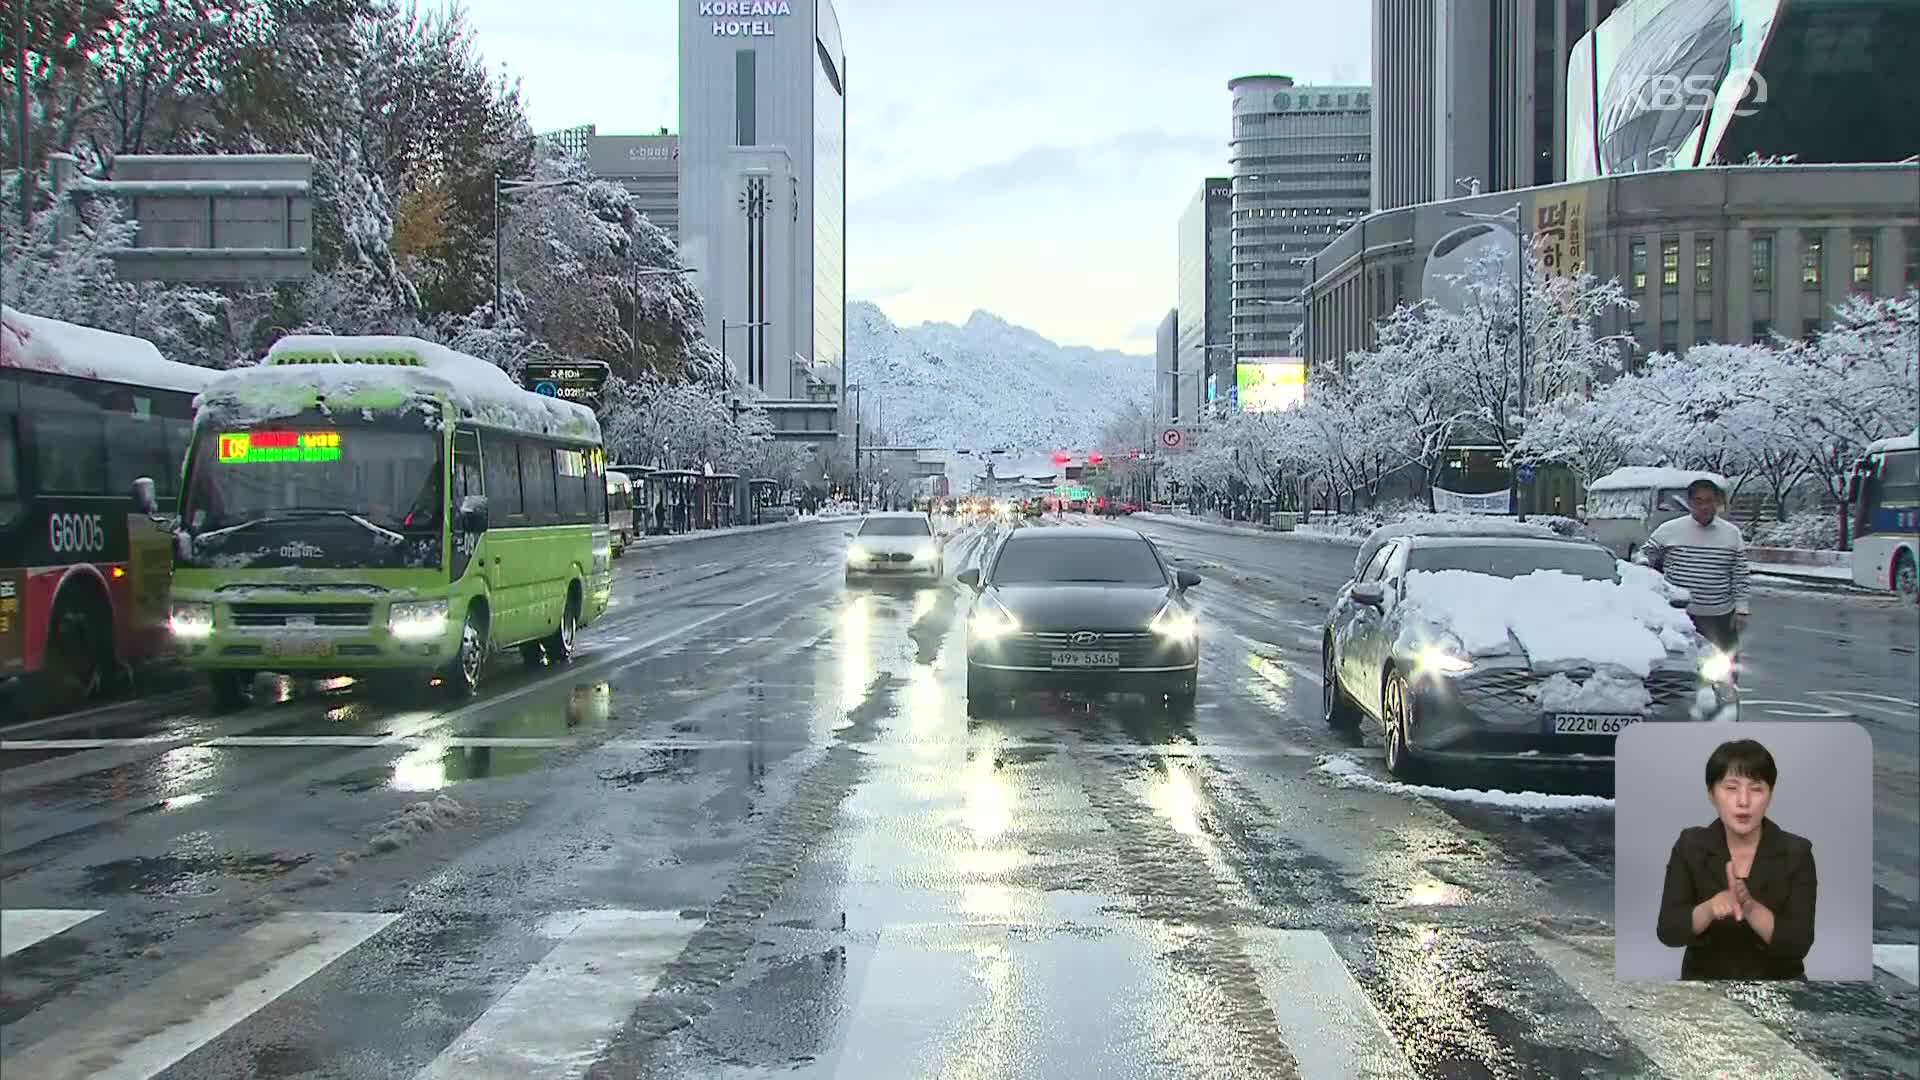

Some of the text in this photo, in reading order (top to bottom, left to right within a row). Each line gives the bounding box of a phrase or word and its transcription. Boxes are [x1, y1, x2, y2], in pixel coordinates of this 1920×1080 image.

[699, 1, 790, 15] KOREANA
[712, 21, 774, 35] HOTEL
[50, 512, 104, 552] G6005
[1084, 652, 1114, 665] 5345
[1600, 717, 1641, 733] 667
